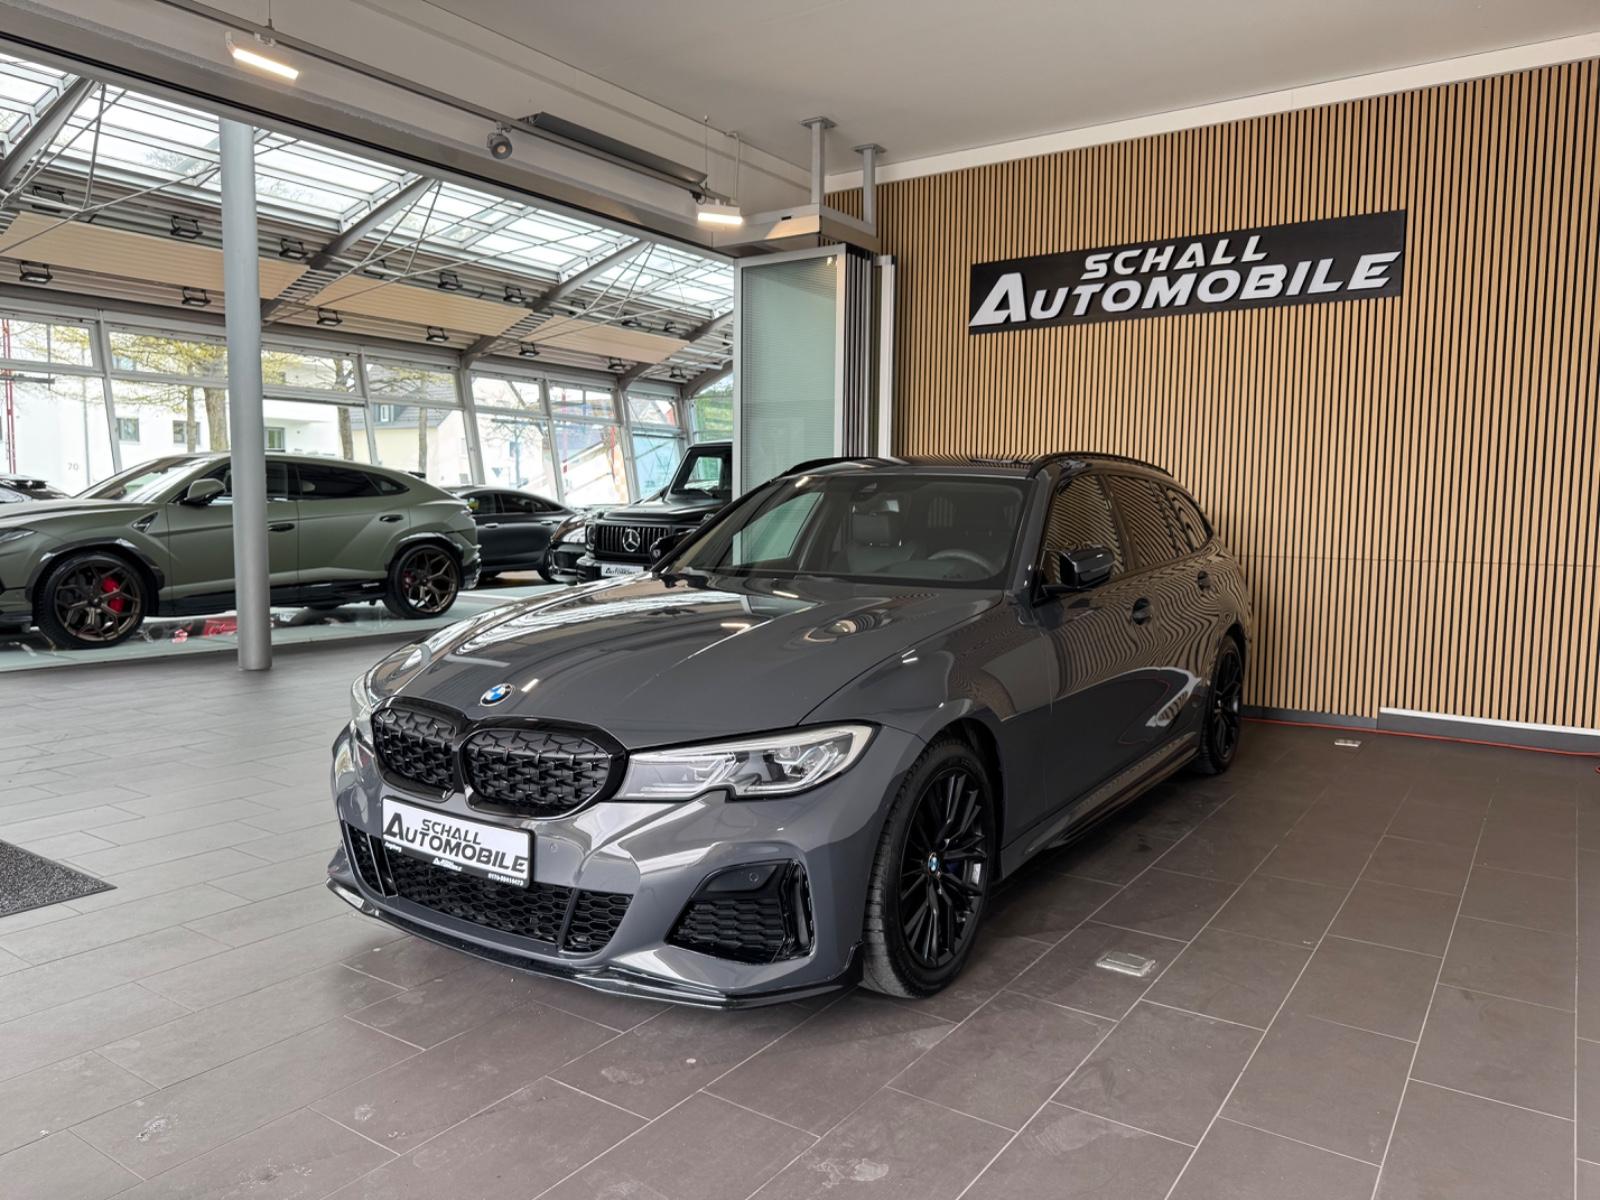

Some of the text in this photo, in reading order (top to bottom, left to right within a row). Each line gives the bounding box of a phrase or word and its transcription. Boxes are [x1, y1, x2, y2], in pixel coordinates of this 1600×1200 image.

[1080, 235, 1268, 280] SCHALL
[968, 251, 1401, 327] AUTOMOBILE
[383, 812, 529, 873] AUTOMOBILE
[421, 818, 481, 846] SCHALL
